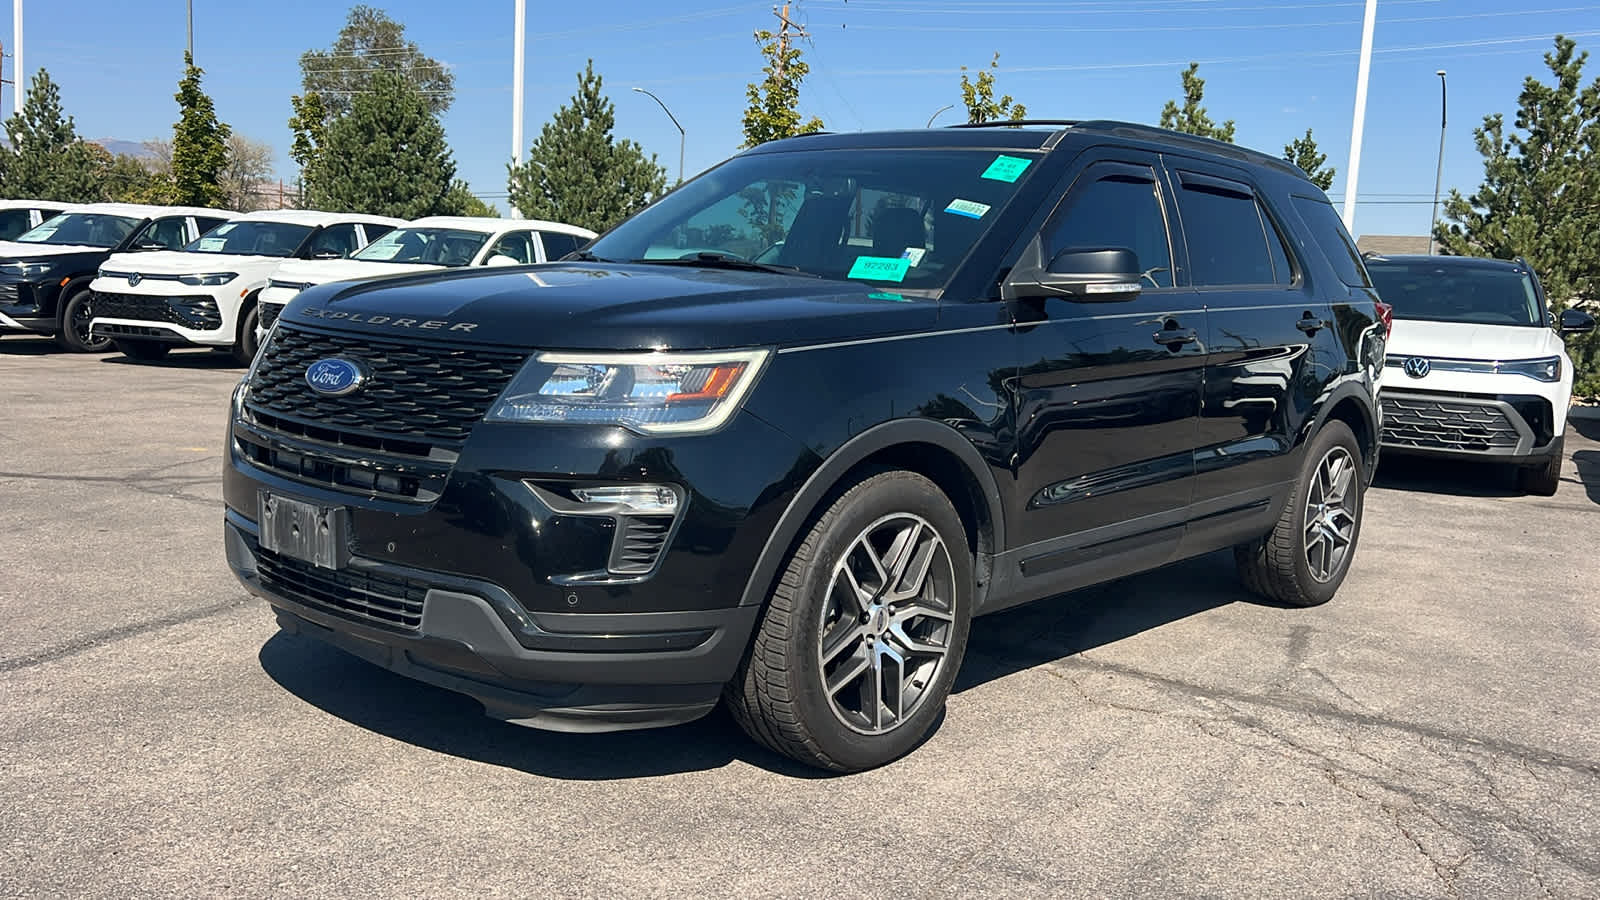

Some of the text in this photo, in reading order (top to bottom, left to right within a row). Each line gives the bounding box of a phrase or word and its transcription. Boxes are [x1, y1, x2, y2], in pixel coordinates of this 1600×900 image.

[302, 305, 478, 332] EXPLORER
[311, 362, 345, 386] Ford
[1405, 357, 1430, 379] VW
